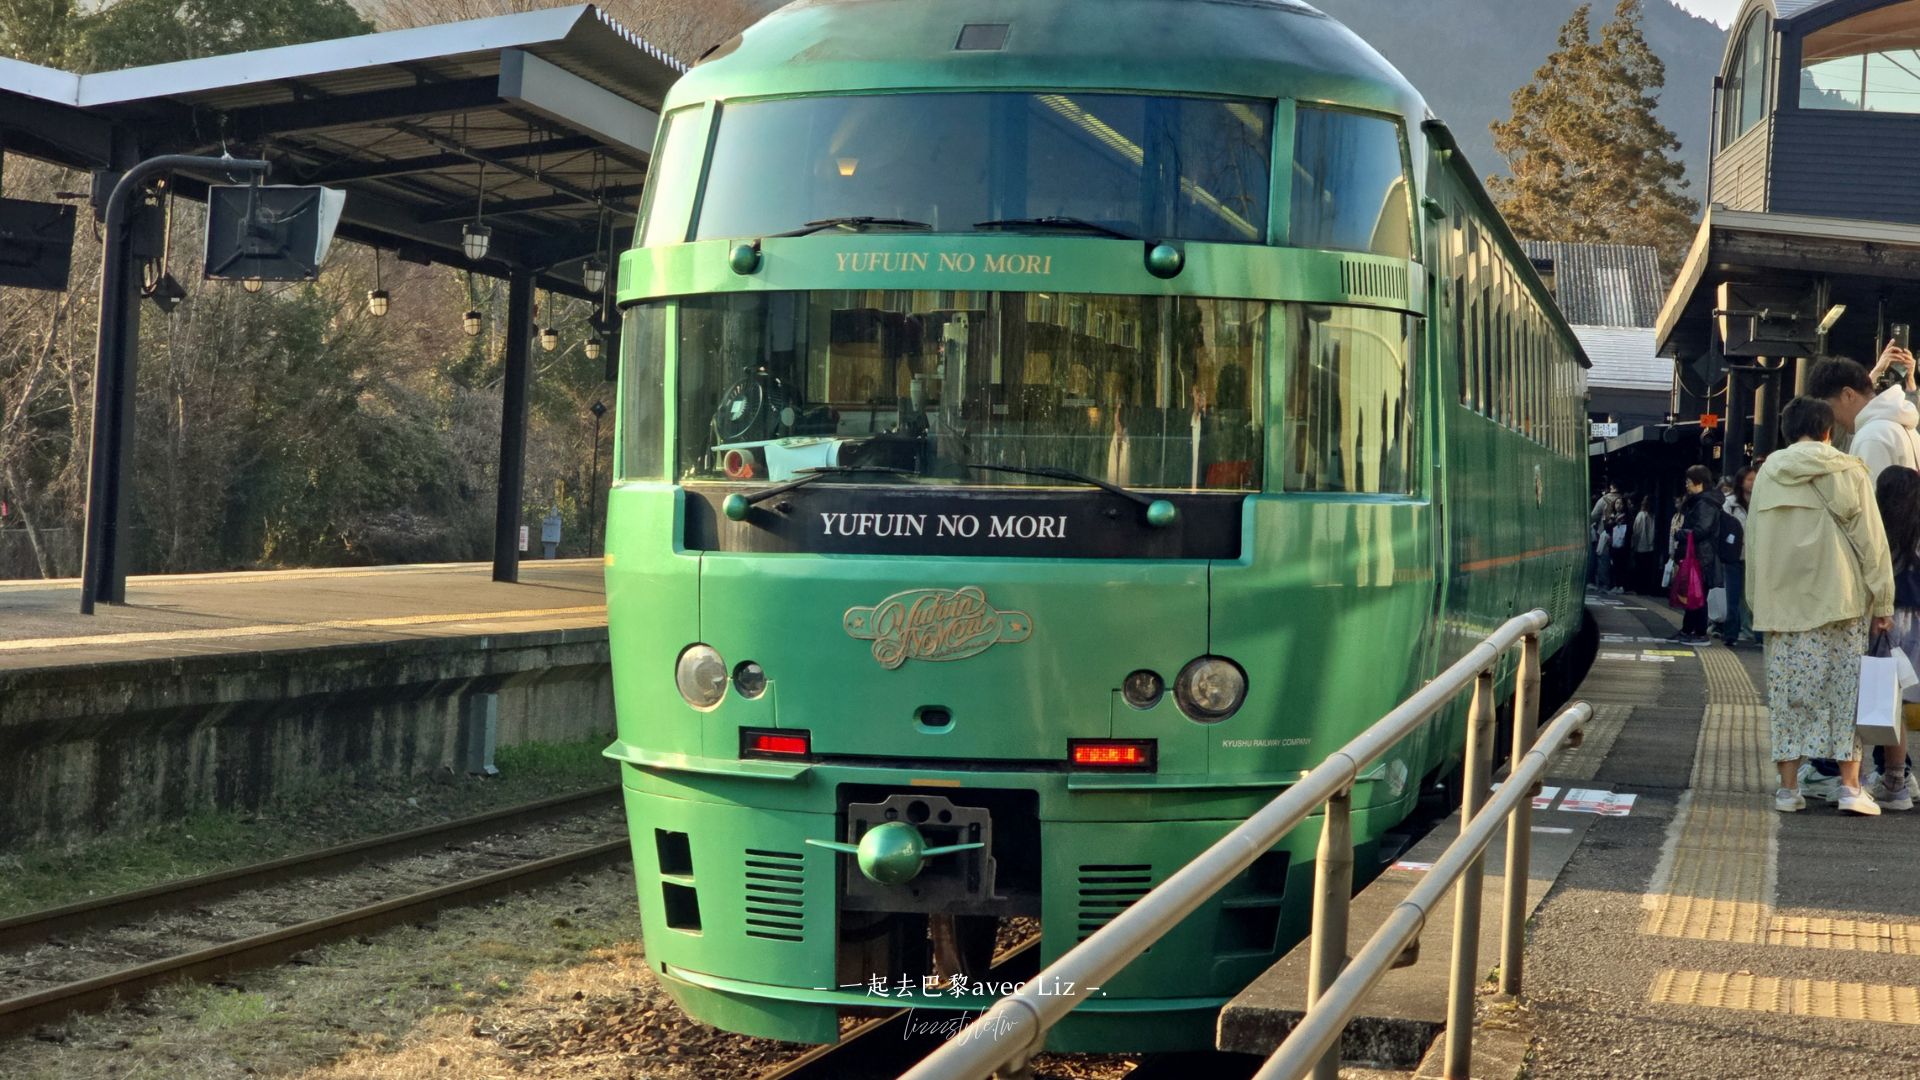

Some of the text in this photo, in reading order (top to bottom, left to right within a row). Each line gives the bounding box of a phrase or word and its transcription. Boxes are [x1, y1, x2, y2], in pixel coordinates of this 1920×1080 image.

[835, 252, 1052, 275] YUFUIN NO MORI
[820, 512, 1068, 539] YUFUIN NO MORI
[1222, 738, 1312, 748] KYUSHU RAILWAY COMPANY
